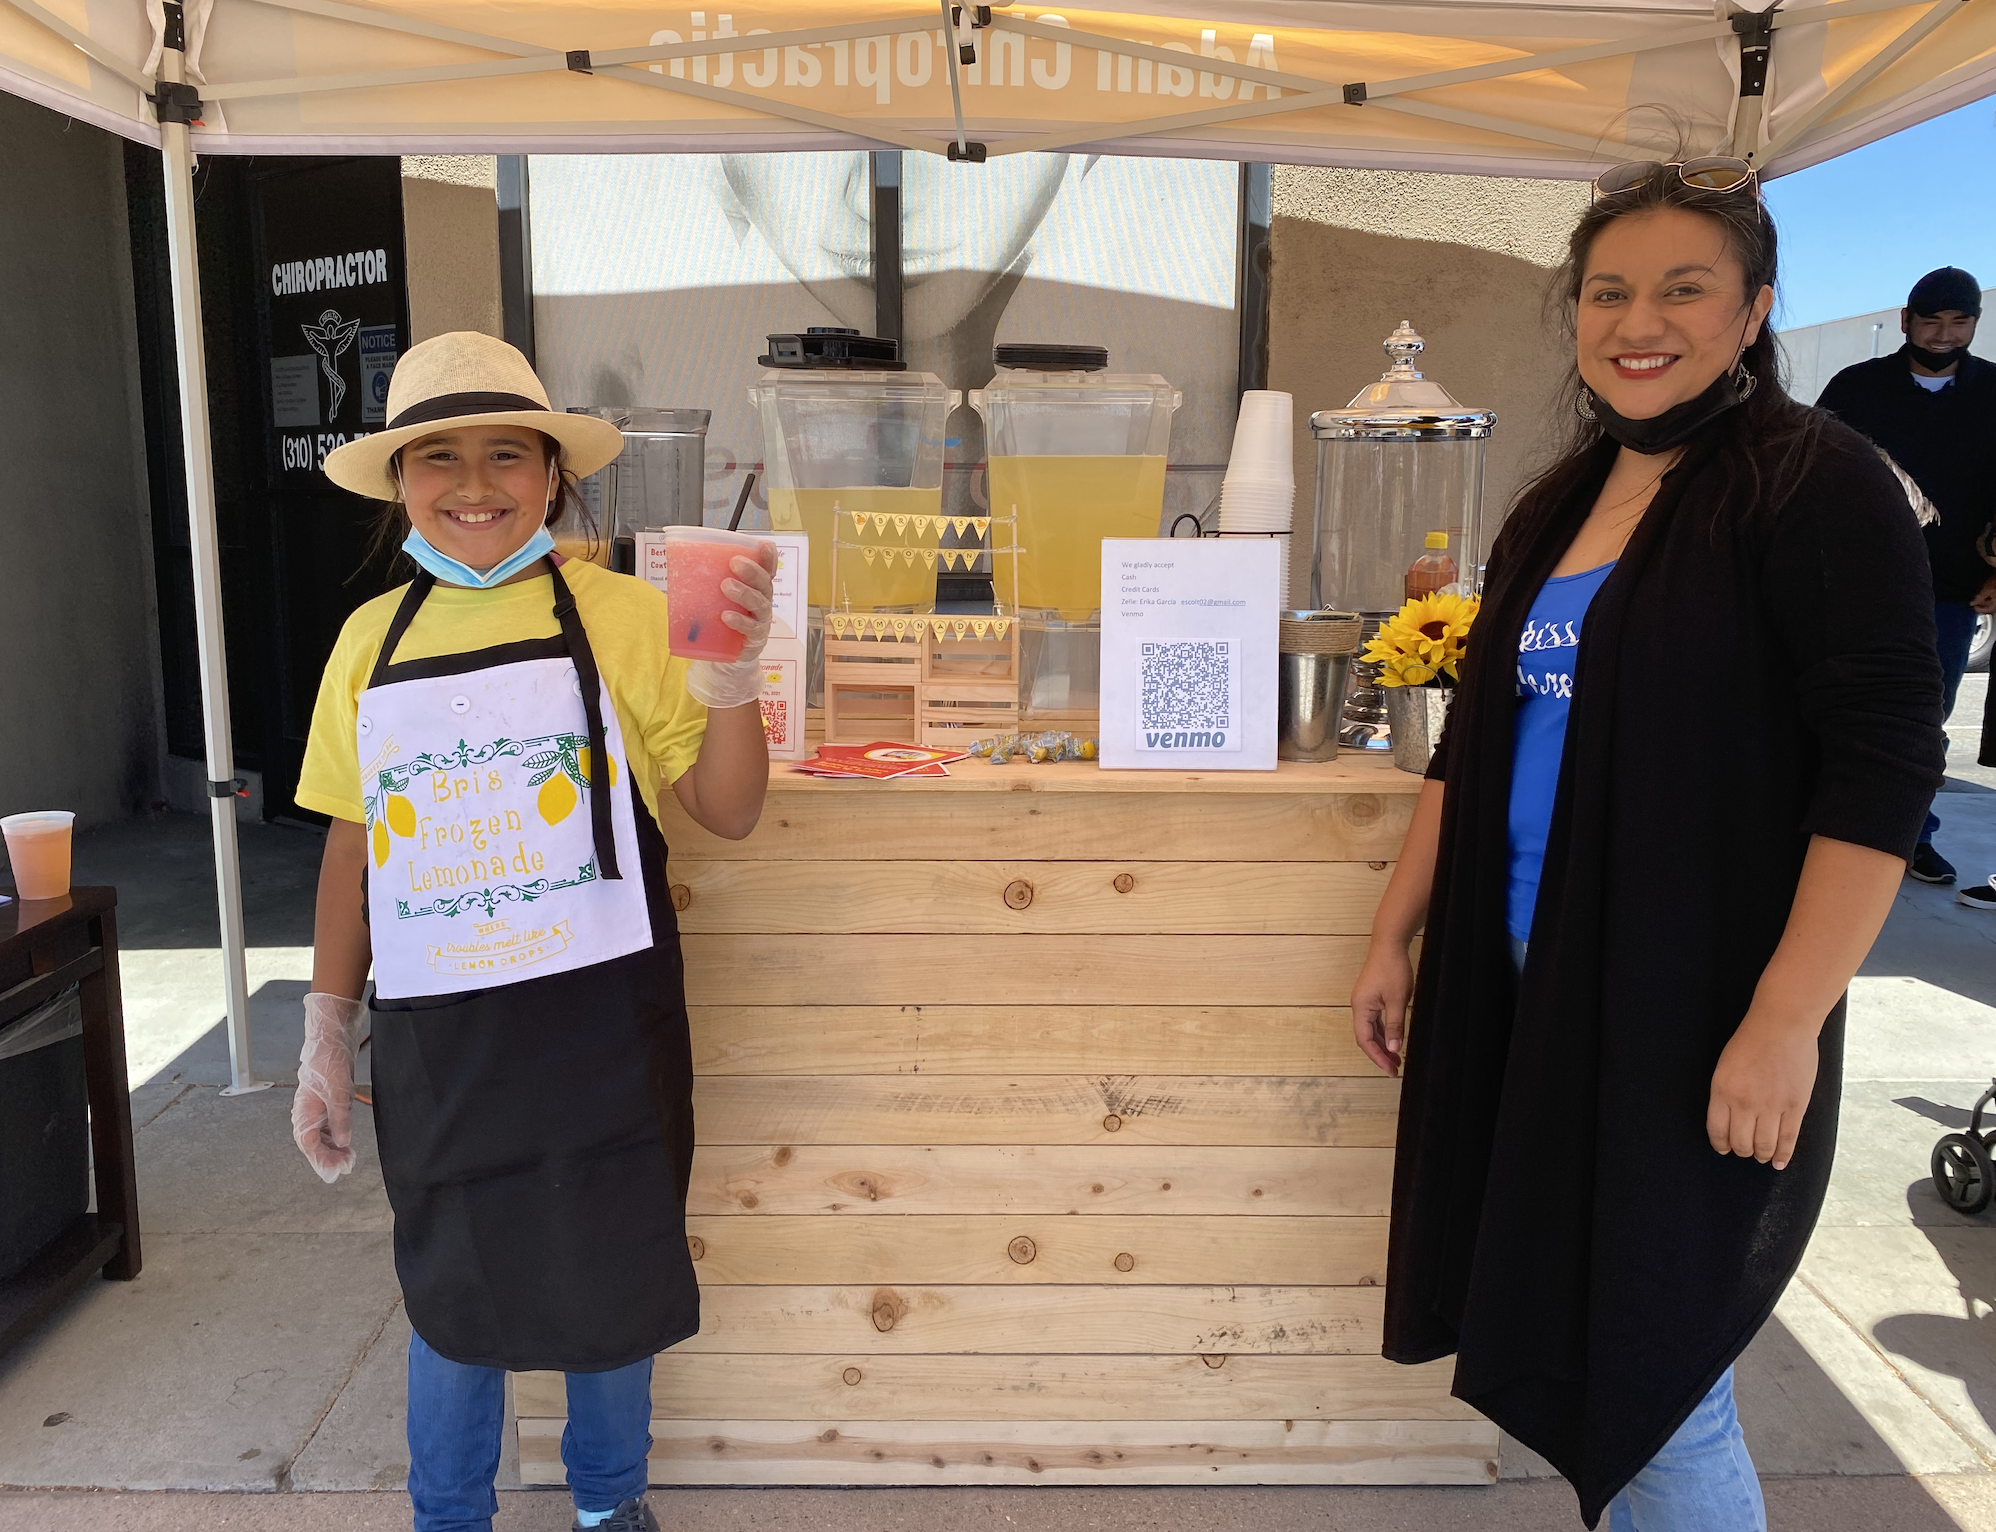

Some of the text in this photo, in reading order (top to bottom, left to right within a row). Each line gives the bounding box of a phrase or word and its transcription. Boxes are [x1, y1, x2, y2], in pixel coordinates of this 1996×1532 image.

[272, 248, 388, 296] CHIROPRACTOR
[362, 333, 396, 349] NOTICE
[365, 354, 395, 363] PLEASE WEAR
[282, 434, 313, 471] (310)
[650, 561, 667, 569] Cont
[1133, 561, 1153, 569] gladly
[1121, 573, 1137, 581] Cash
[759, 663, 784, 671] onade
[1145, 730, 1226, 748] venmo
[430, 765, 503, 803] Bri's
[418, 809, 522, 851] Frozen
[407, 841, 545, 893] Lemonade
[477, 920, 507, 934] WHERE
[446, 928, 546, 953] troubles melt like
[454, 946, 545, 970] LEMON DROPS
